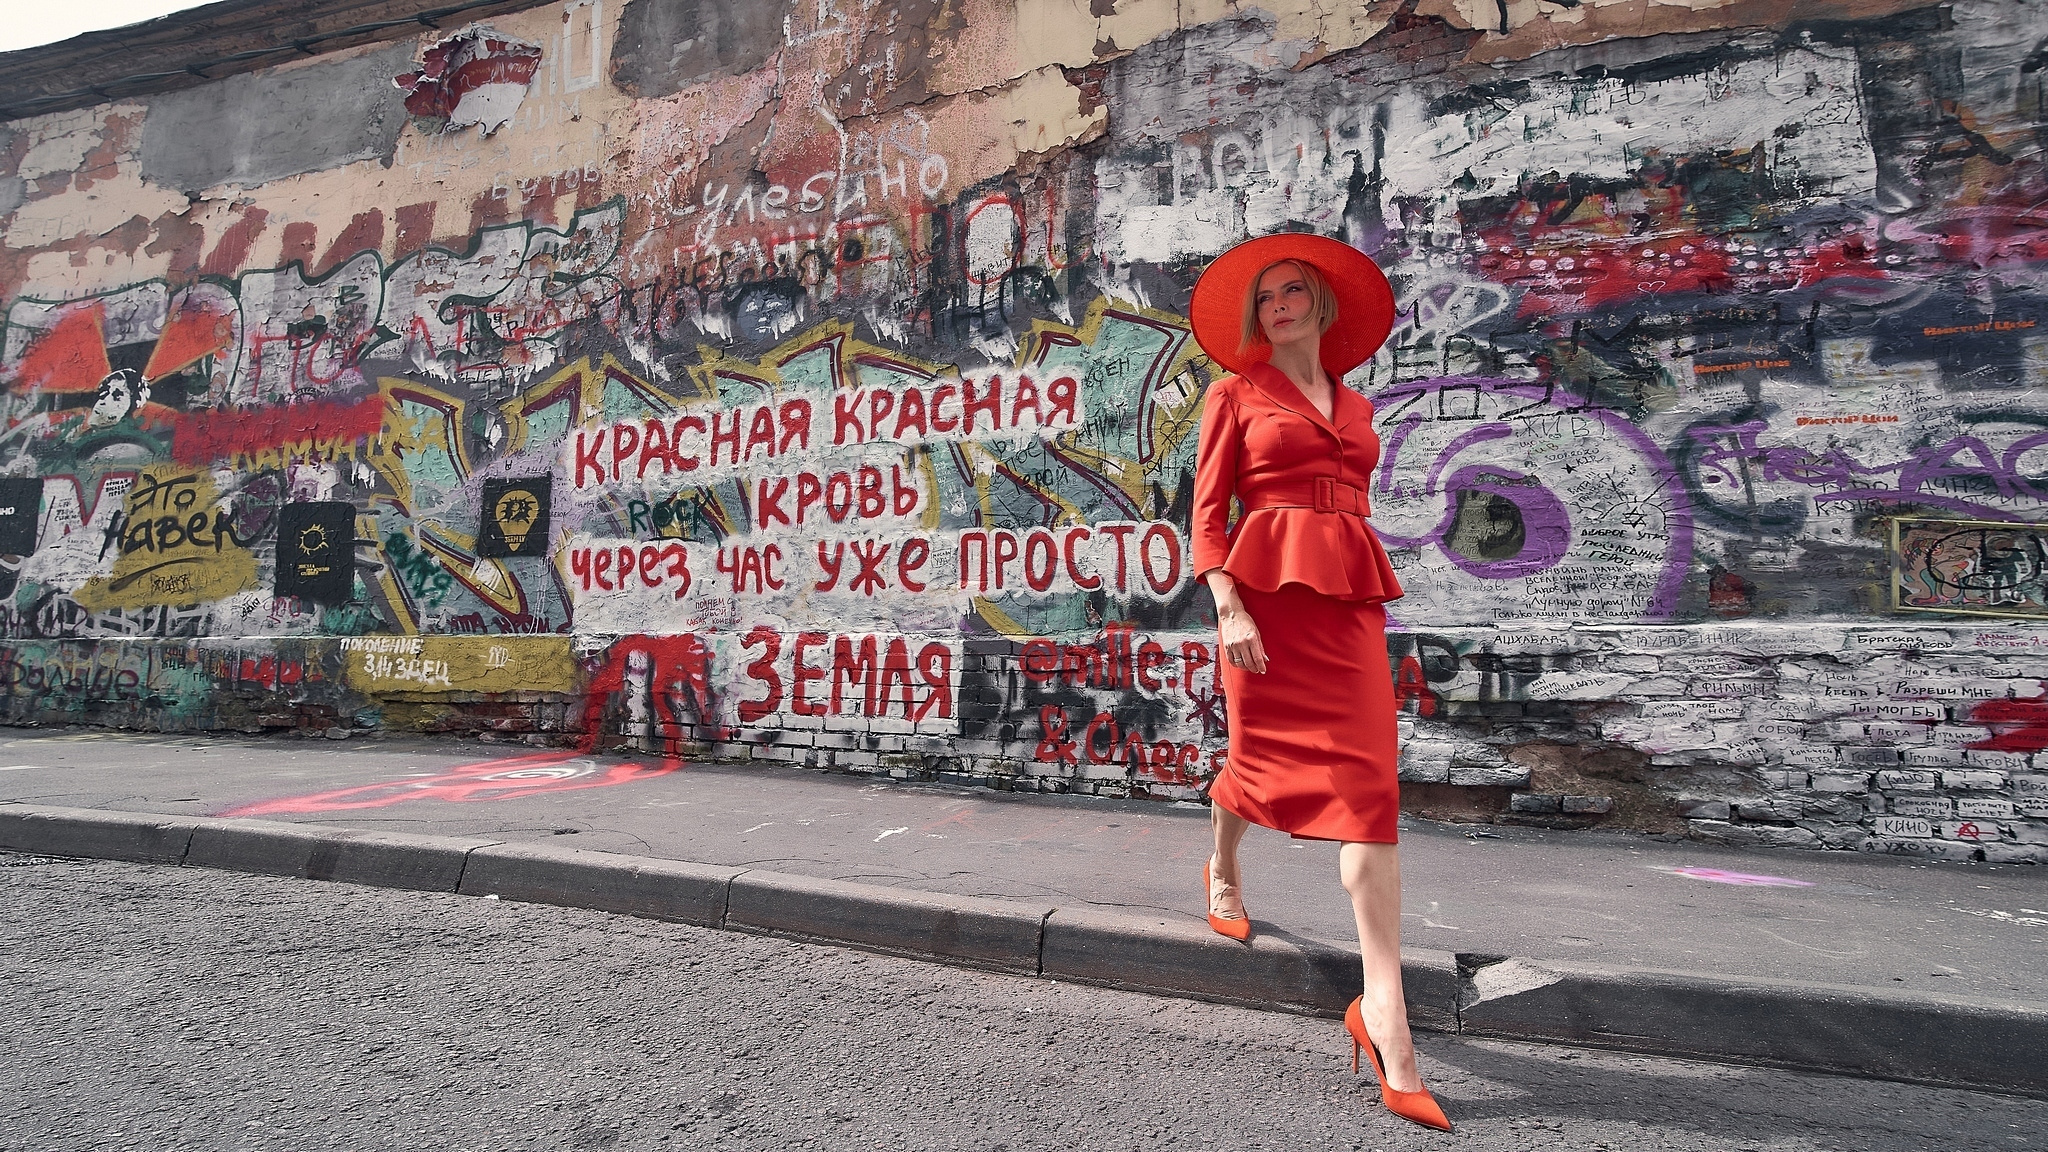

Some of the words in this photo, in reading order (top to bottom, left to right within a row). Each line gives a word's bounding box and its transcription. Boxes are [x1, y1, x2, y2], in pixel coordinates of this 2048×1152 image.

[574, 399, 812, 489] КРАСНАЯ
[833, 374, 1077, 445] КРАСНАЯ
[628, 486, 722, 547] ROCK
[758, 461, 918, 531] КРОВЬ
[960, 523, 1181, 595] ПРОСТО
[737, 624, 953, 723] ЗЕМЛЯ
[1961, 686, 1993, 698] МНЕ
[1877, 729, 1911, 738] ПОРА
[1884, 819, 1929, 834] КИНО
